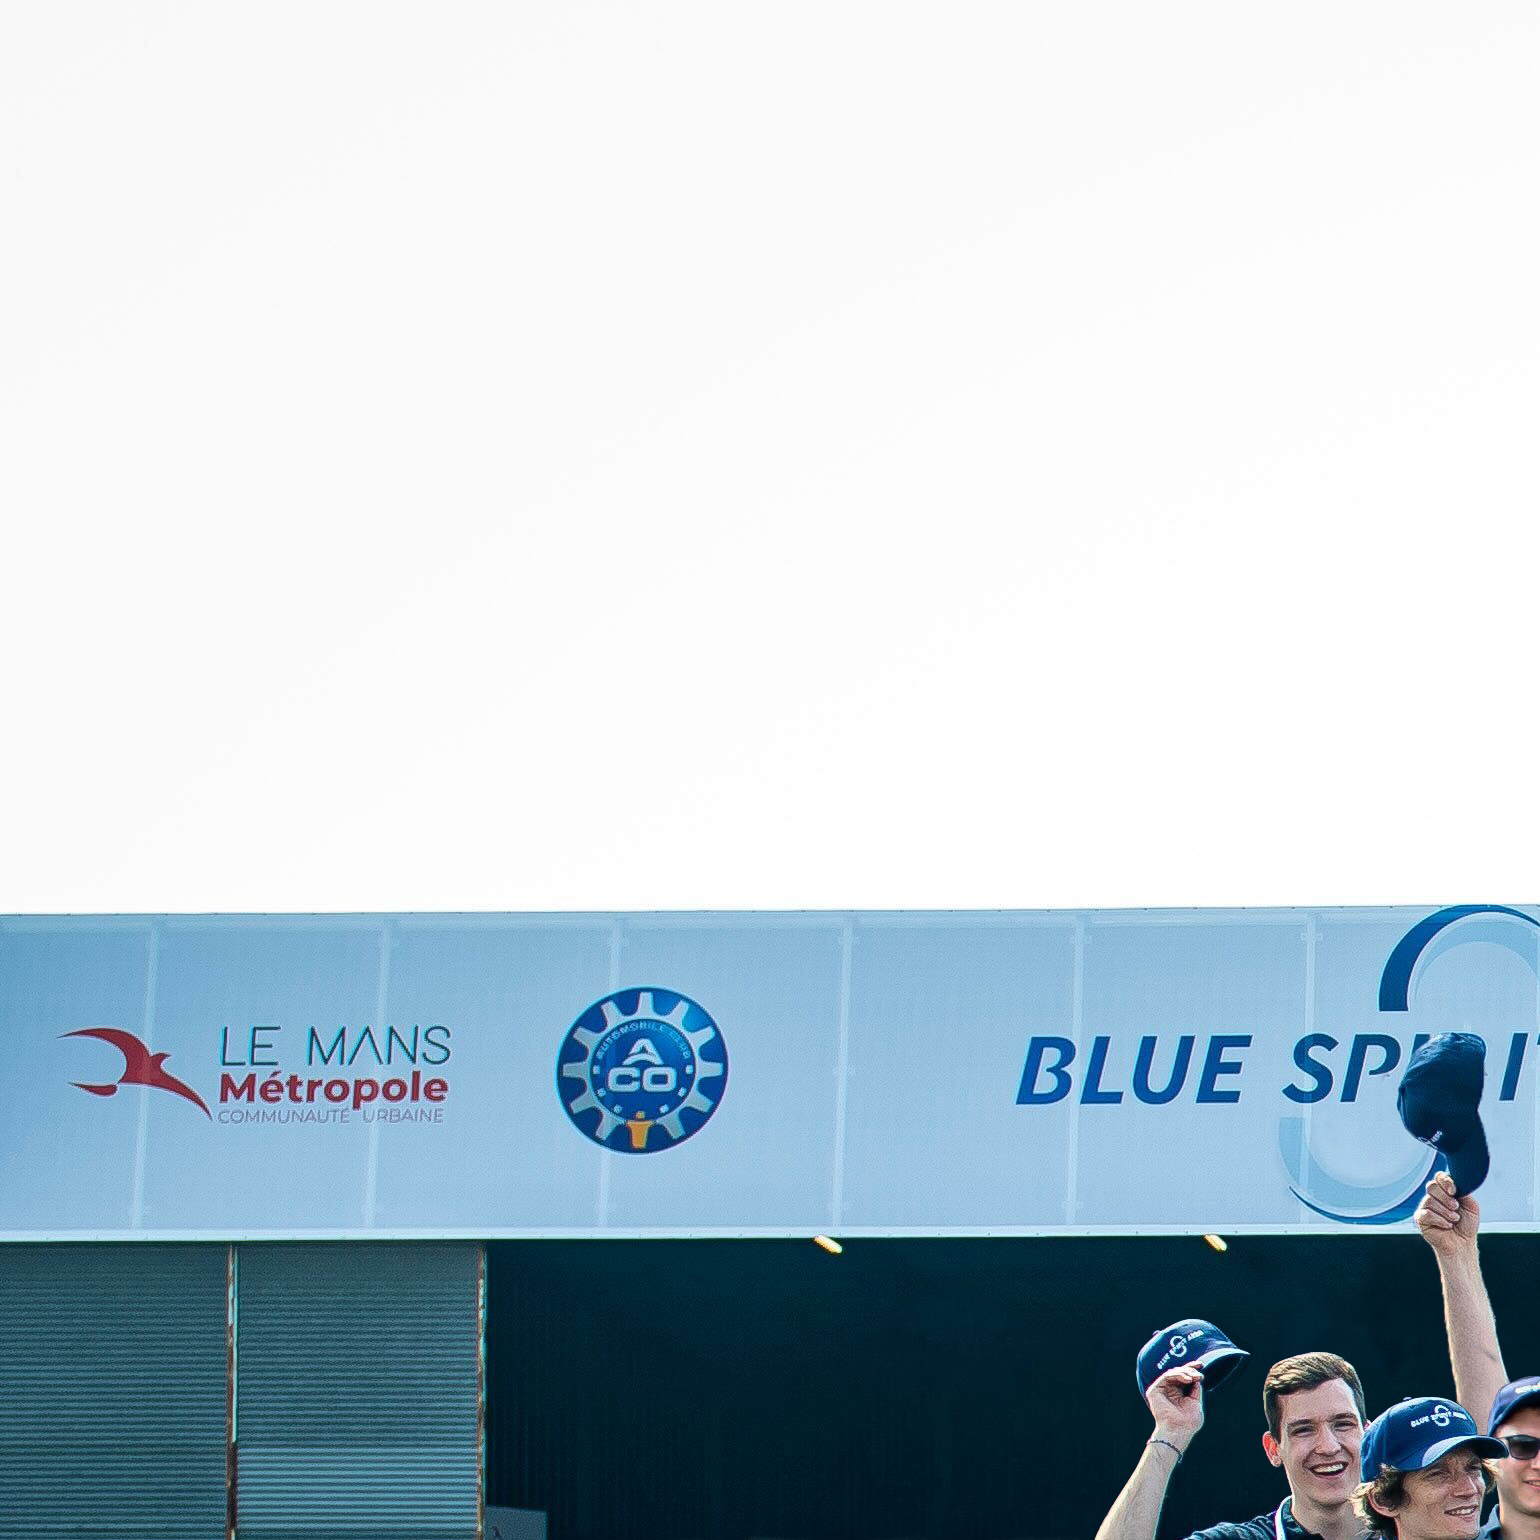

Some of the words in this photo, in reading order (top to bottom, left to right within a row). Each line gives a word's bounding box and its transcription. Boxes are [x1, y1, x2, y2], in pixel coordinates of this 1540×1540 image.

[222, 1025, 281, 1066] LE
[307, 1025, 451, 1066] MANS
[219, 1070, 449, 1111] Métropole
[1016, 1035, 1253, 1106] BLUE
[217, 1108, 350, 1124] COMMUNAUTÉ
[362, 1107, 445, 1123] URBAINE
